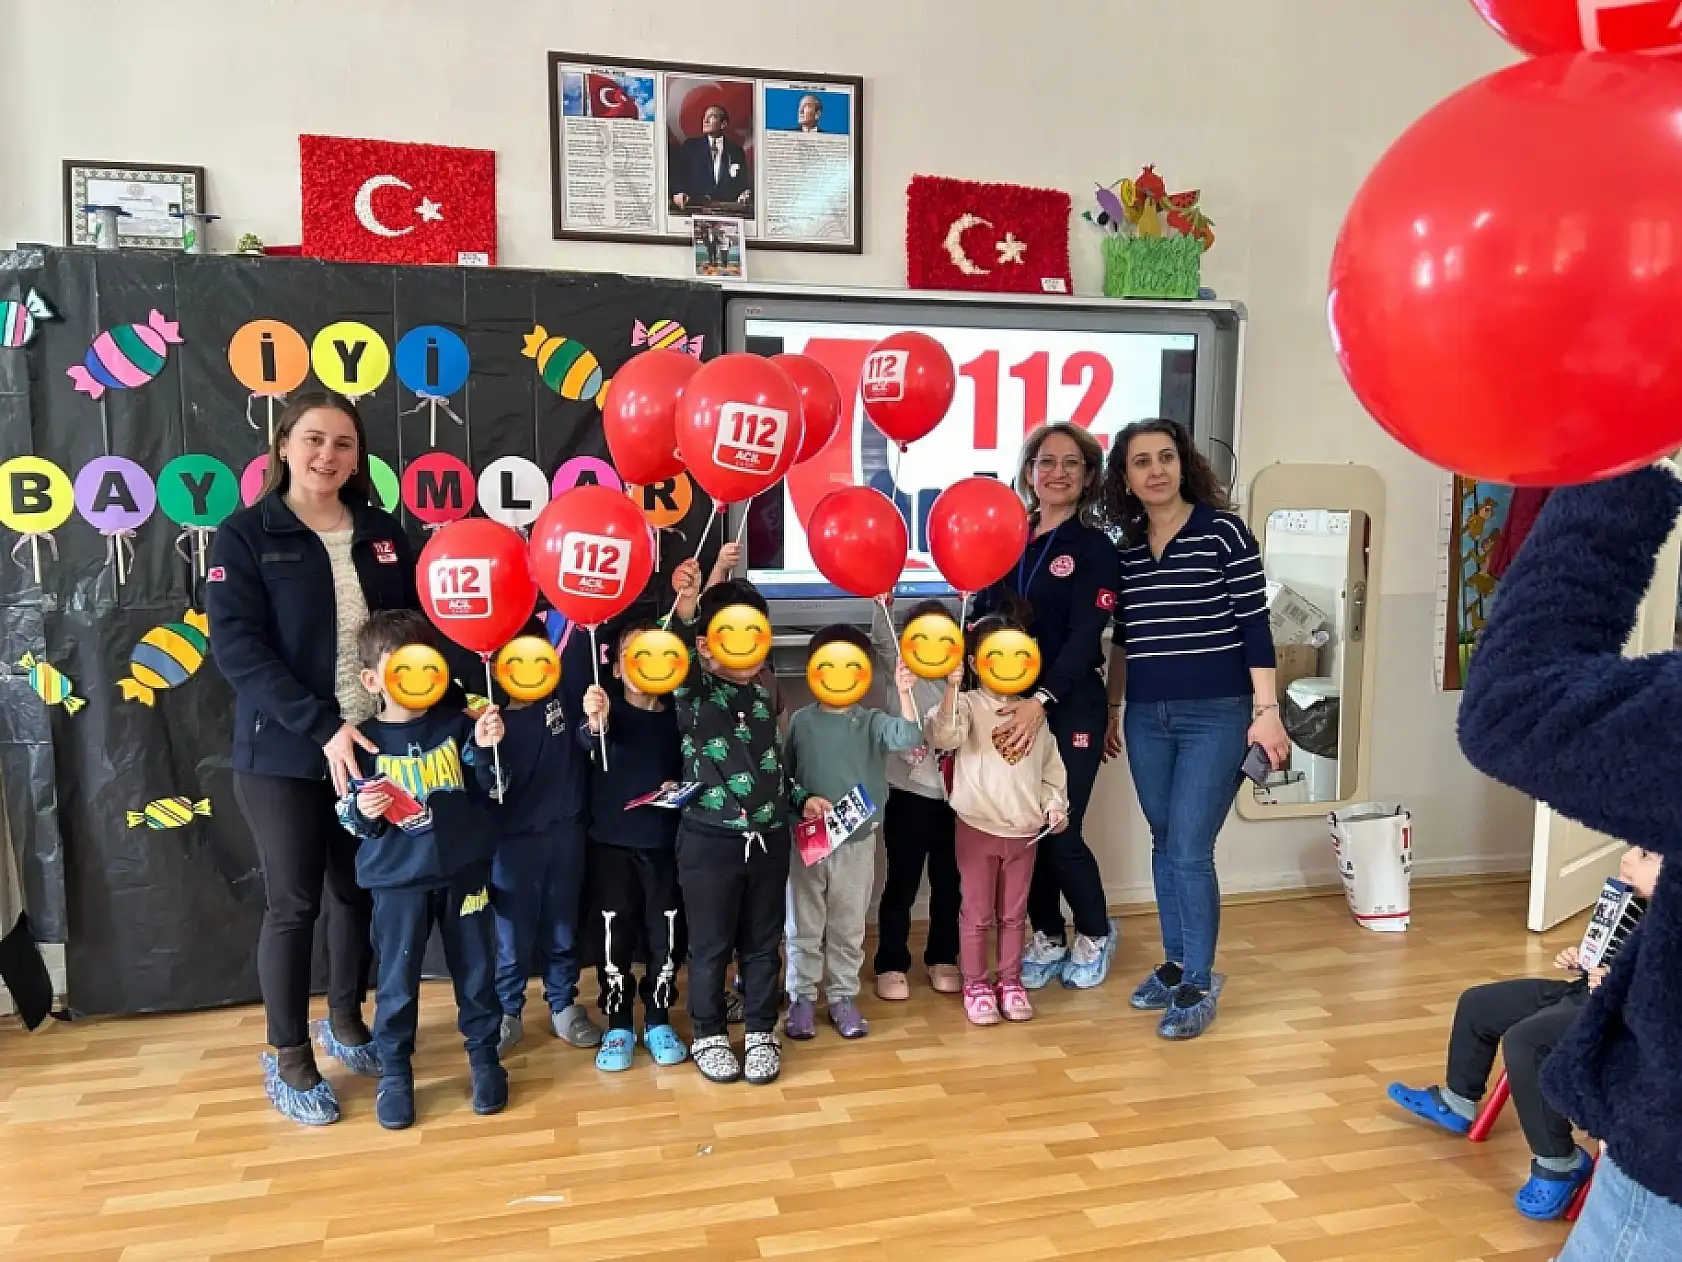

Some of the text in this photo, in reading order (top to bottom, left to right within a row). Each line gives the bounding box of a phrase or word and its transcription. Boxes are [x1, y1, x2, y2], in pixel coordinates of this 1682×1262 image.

[868, 355, 898, 379] 112
[959, 349, 1114, 449] 112
[731, 411, 778, 448] 112
[573, 541, 621, 575] 112
[437, 565, 481, 594] 112
